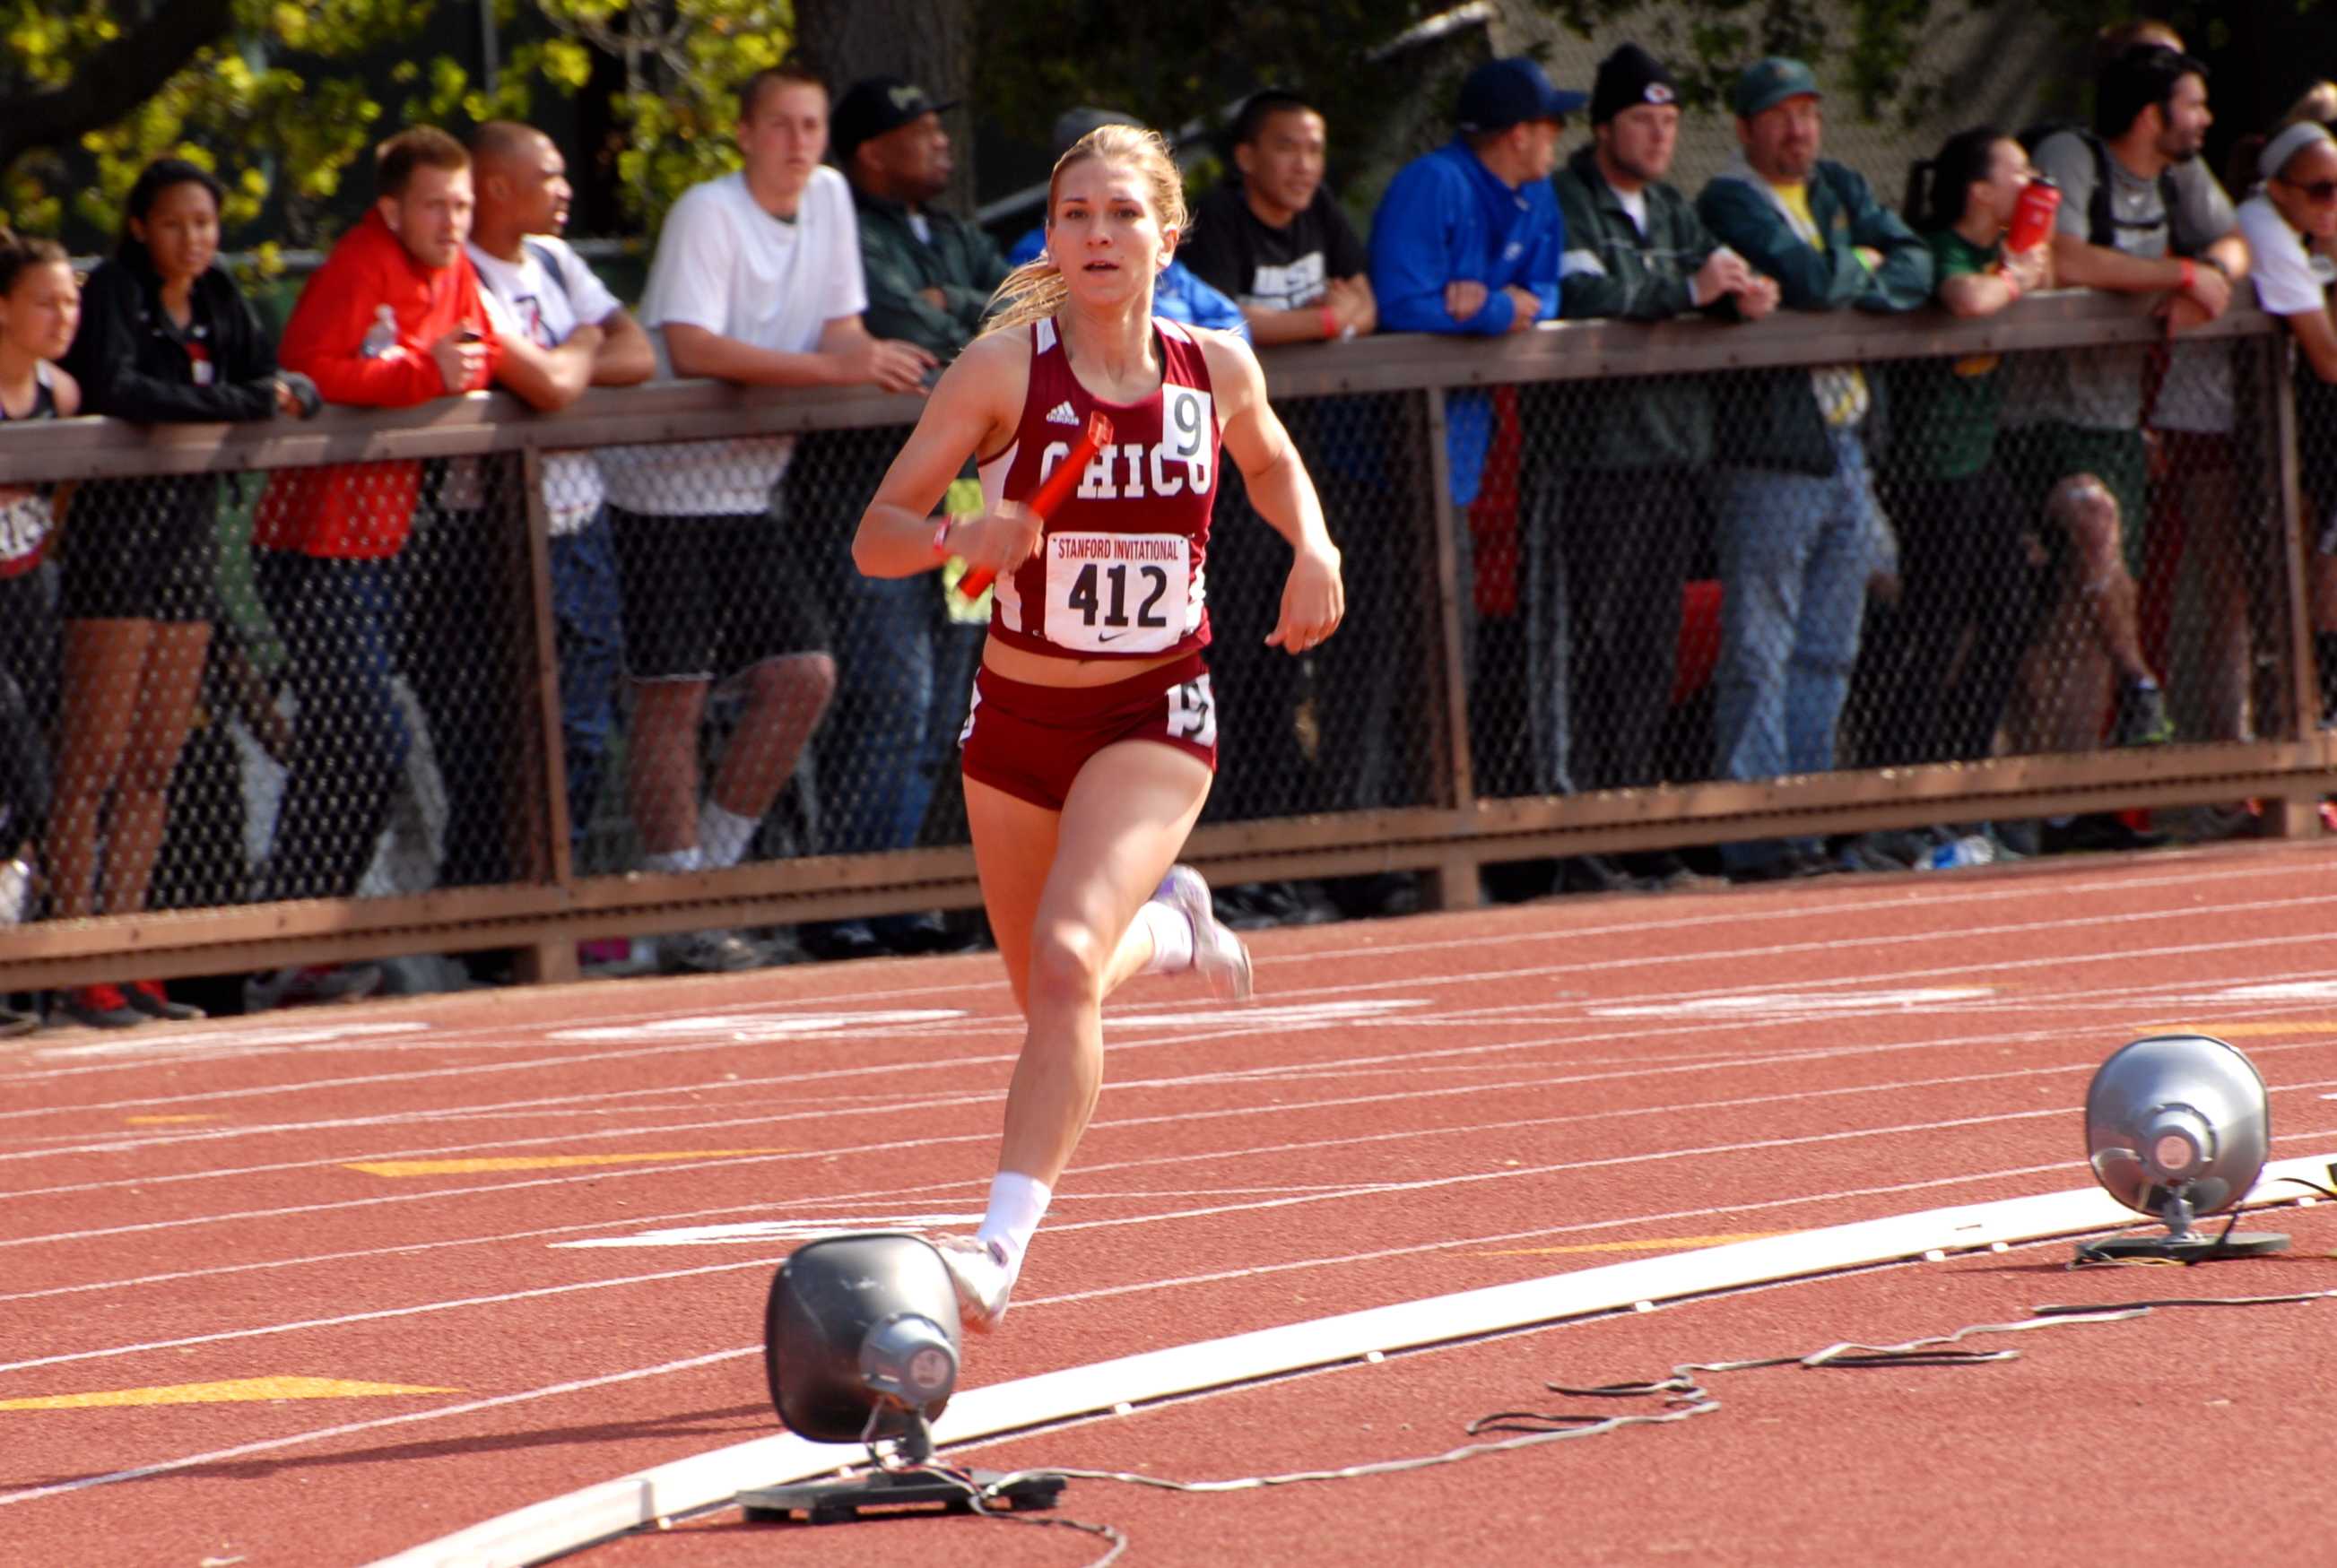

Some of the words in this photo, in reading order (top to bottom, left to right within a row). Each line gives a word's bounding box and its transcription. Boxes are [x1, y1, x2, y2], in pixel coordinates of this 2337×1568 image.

[1174, 393, 1202, 456] 9
[1058, 539, 1111, 559] STANFORD
[1114, 540, 1178, 560] INVITATIONAL
[1068, 563, 1167, 628] 412
